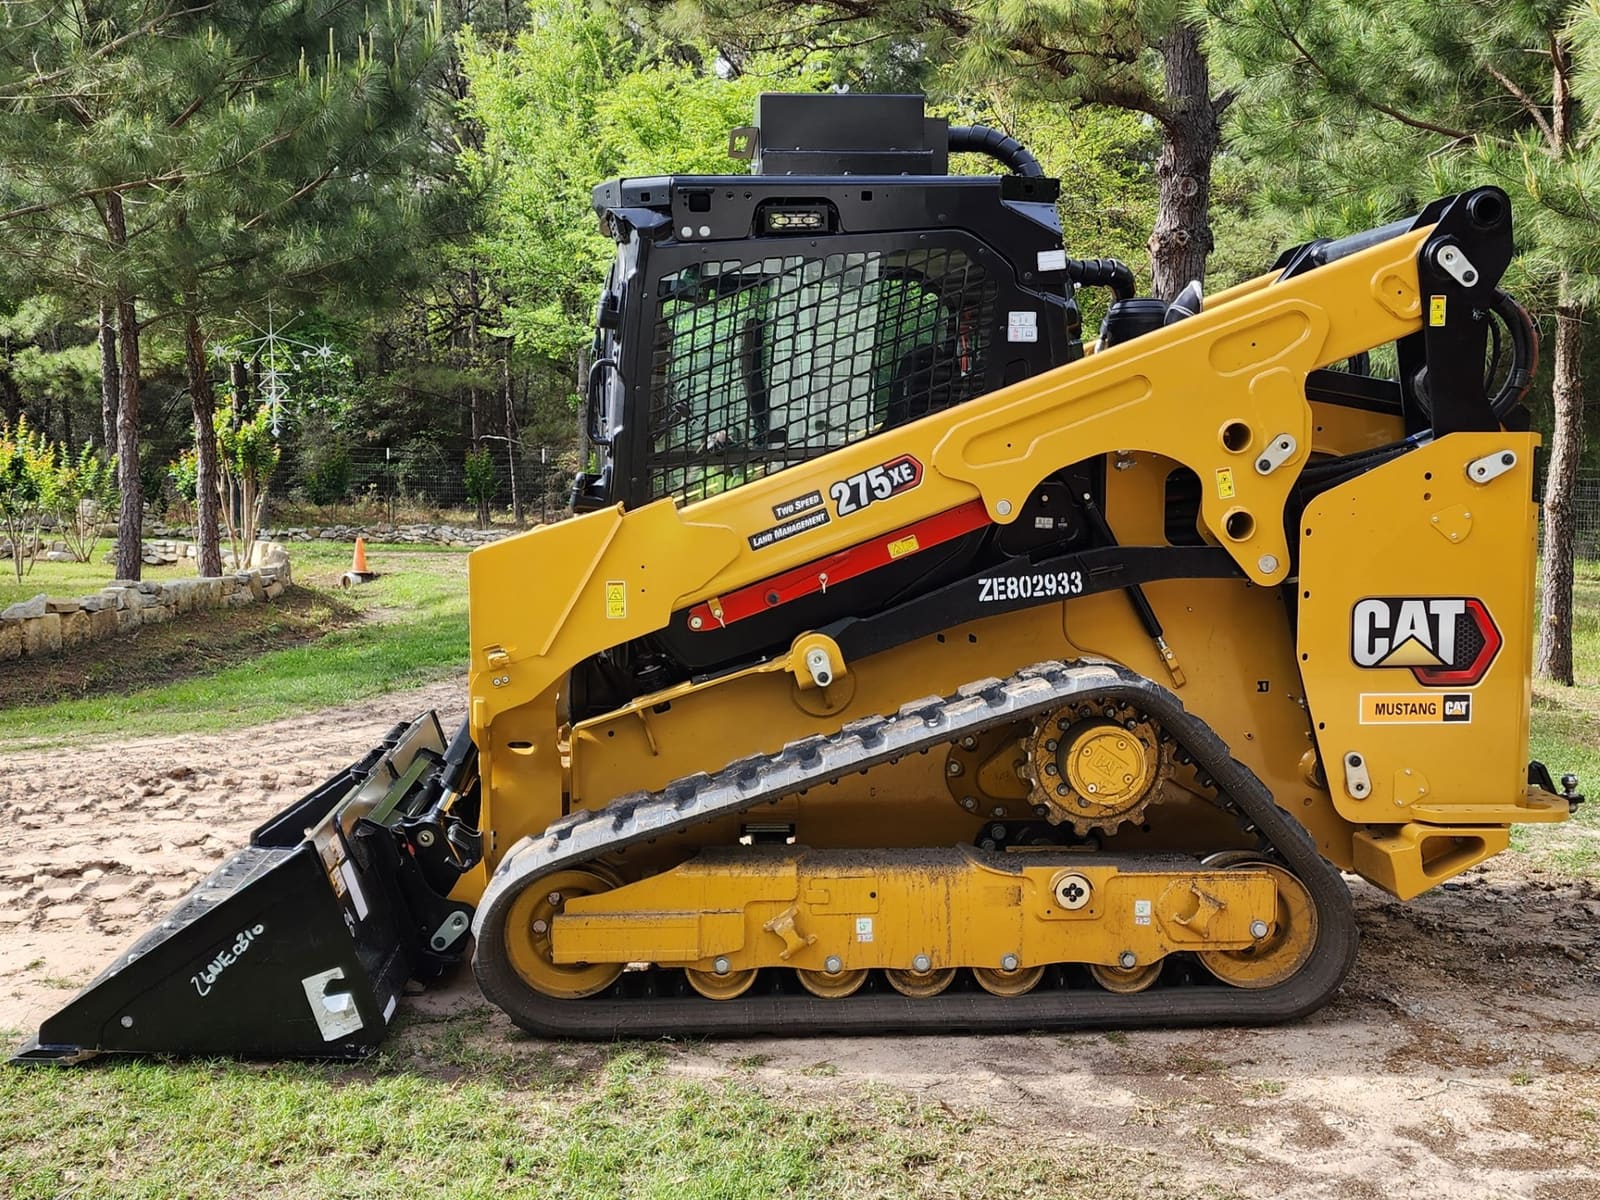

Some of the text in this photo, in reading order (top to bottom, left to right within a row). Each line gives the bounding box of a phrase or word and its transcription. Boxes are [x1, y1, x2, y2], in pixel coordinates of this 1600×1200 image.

[776, 495, 819, 517] TWO SPEED
[753, 513, 825, 547] LAND MANAGEMENT
[978, 571, 1083, 602] ZE802933
[1353, 599, 1466, 667] CAT
[1375, 701, 1469, 716] MUSTANG CAT
